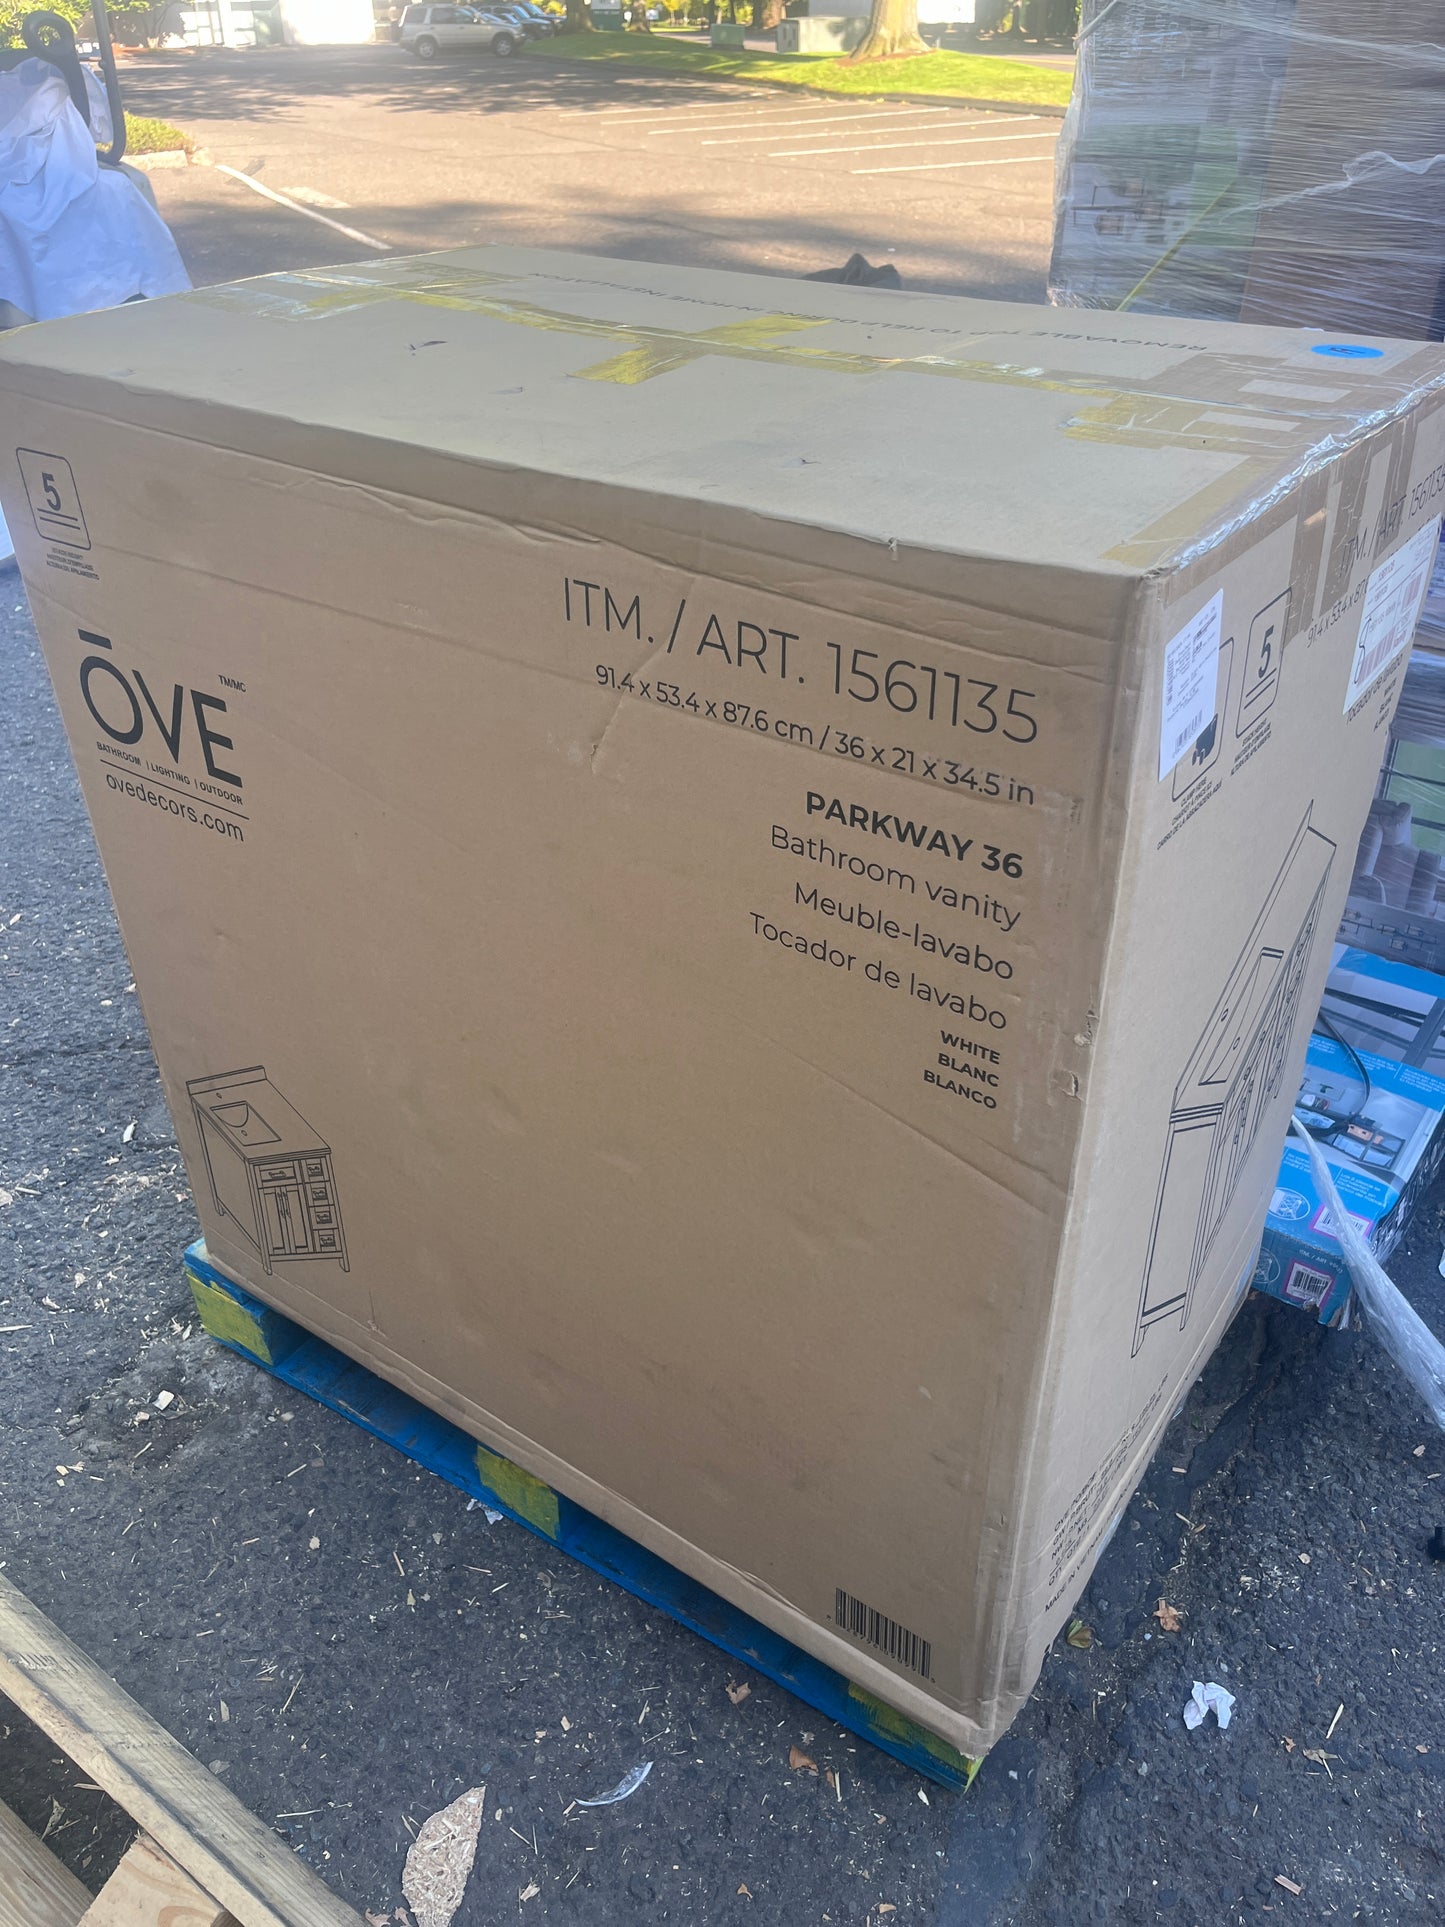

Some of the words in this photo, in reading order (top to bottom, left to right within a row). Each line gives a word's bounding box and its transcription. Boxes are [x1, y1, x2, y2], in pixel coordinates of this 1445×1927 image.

[527, 271, 667, 298] INSTALLATION
[766, 308, 858, 325] DURING
[860, 320, 926, 332] HELP
[930, 327, 963, 336] TO
[1030, 330, 1208, 352] REMOVABLE
[42, 472, 62, 512] 5
[563, 577, 656, 645] ITM.
[667, 598, 687, 653] /
[696, 613, 806, 685] ART.
[827, 641, 1039, 744] 1561135
[1258, 624, 1274, 679] 5
[595, 664, 635, 693] 91.4
[639, 680, 652, 699] x
[656, 681, 701, 714] 53.4
[704, 701, 718, 719] x
[722, 700, 770, 733] 87.6
[774, 718, 814, 746] cm
[818, 725, 831, 751] /
[834, 731, 866, 760] 36
[871, 746, 887, 766] x
[891, 747, 916, 774] 21
[922, 759, 938, 781] x
[943, 761, 1001, 797] 34.5
[1008, 777, 1036, 806] in
[96, 741, 142, 767] BATHROOM
[151, 762, 192, 786] LIGHTING
[199, 781, 243, 807] OUTDOOR
[105, 772, 245, 842] ovedecors.com
[806, 791, 974, 862] PARKWAY
[981, 844, 1025, 879] 36
[771, 824, 915, 893] Bathroom
[925, 880, 1022, 932] vanity
[794, 882, 1014, 980] Meuble-lavabo
[750, 911, 857, 971] Tocador
[864, 960, 901, 989] de
[910, 972, 1007, 1030] lavabo
[937, 1052, 1000, 1088] BLANC
[940, 1029, 1001, 1065] WHITE
[923, 1069, 998, 1109] BLANCO
